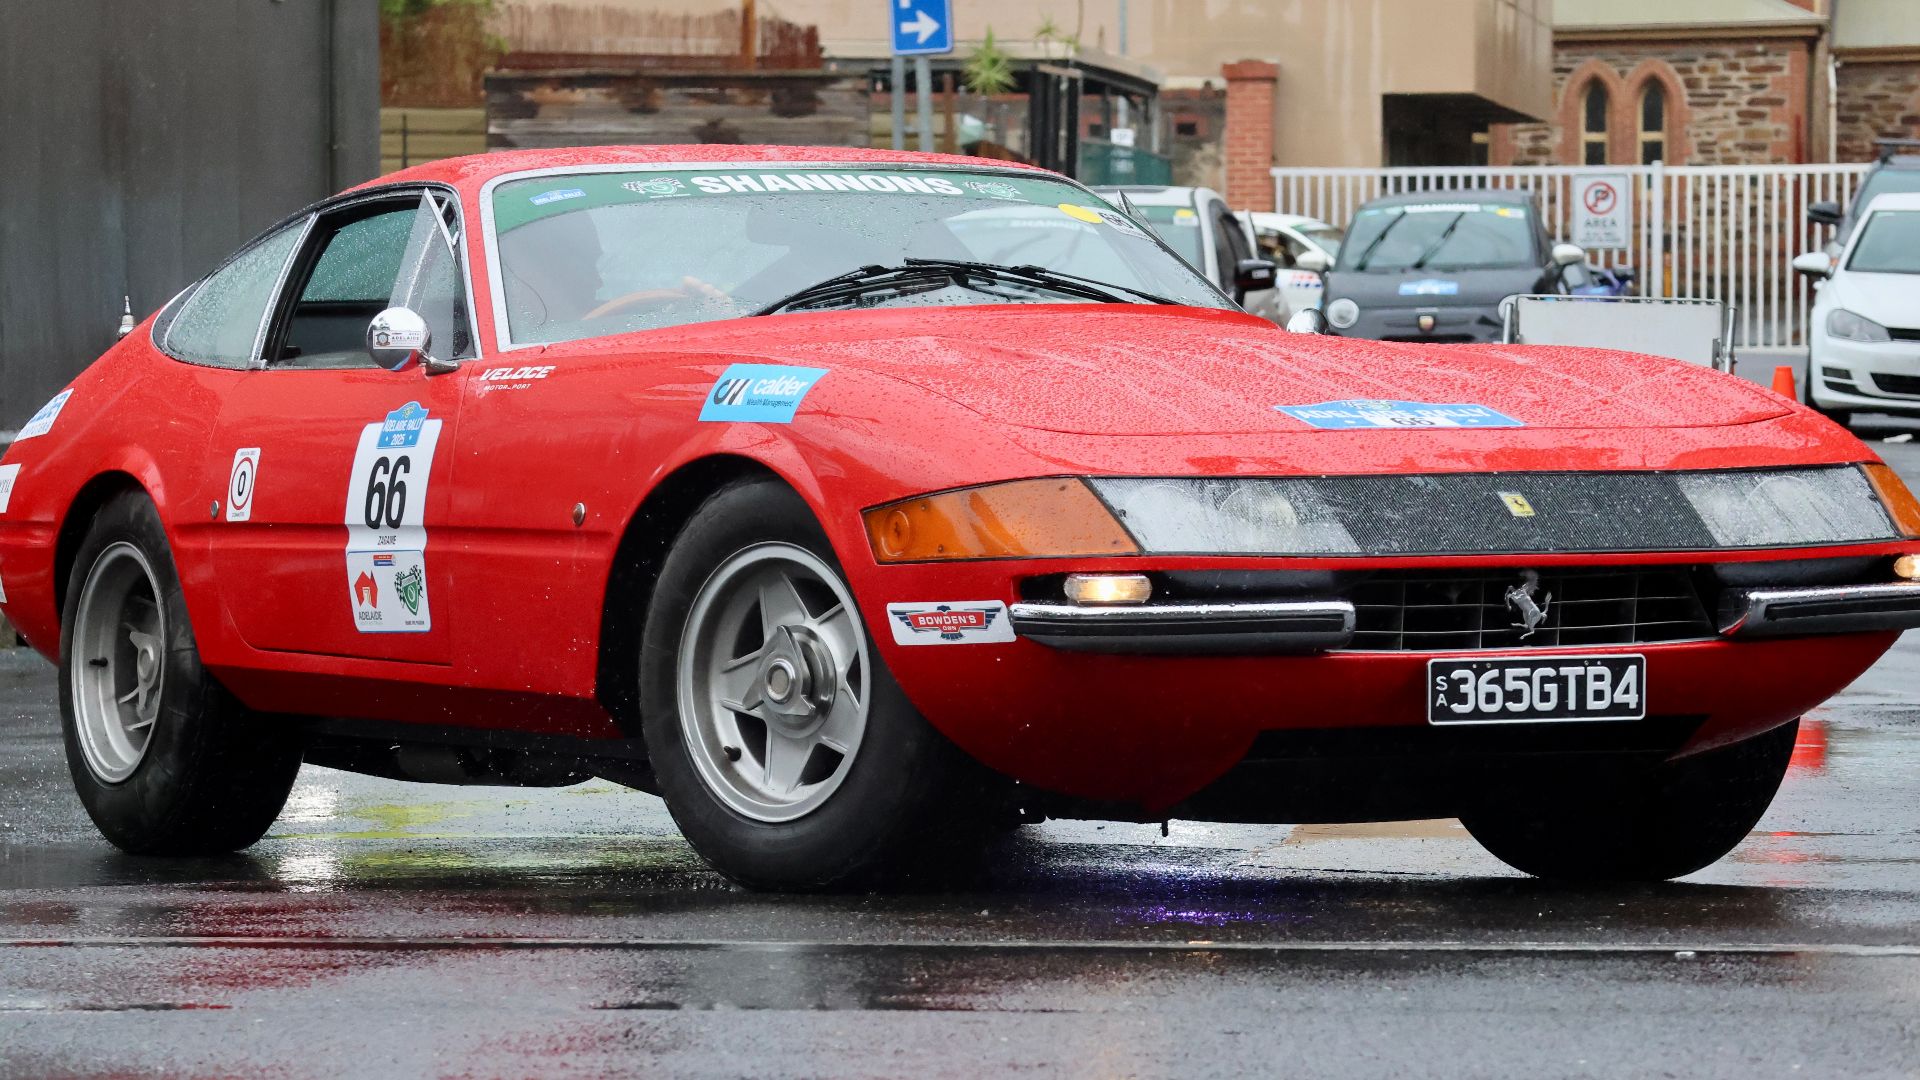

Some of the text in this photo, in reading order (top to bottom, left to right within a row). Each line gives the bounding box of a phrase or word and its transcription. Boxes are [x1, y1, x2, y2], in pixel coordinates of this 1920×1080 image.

[691, 174, 963, 196] SHANNONS
[480, 365, 556, 381] VELOCE
[753, 375, 809, 396] calder
[1294, 407, 1492, 418] ADELAIDE RALLY
[406, 417, 425, 430] RALLY
[1390, 417, 1436, 426] 66
[390, 433, 407, 446] 2025
[237, 470, 247, 497] 0
[365, 455, 411, 529] 66
[359, 611, 382, 620] ADELAIDE
[918, 614, 977, 626] BOWDEN'S
[1450, 664, 1639, 714] 365GTB4
